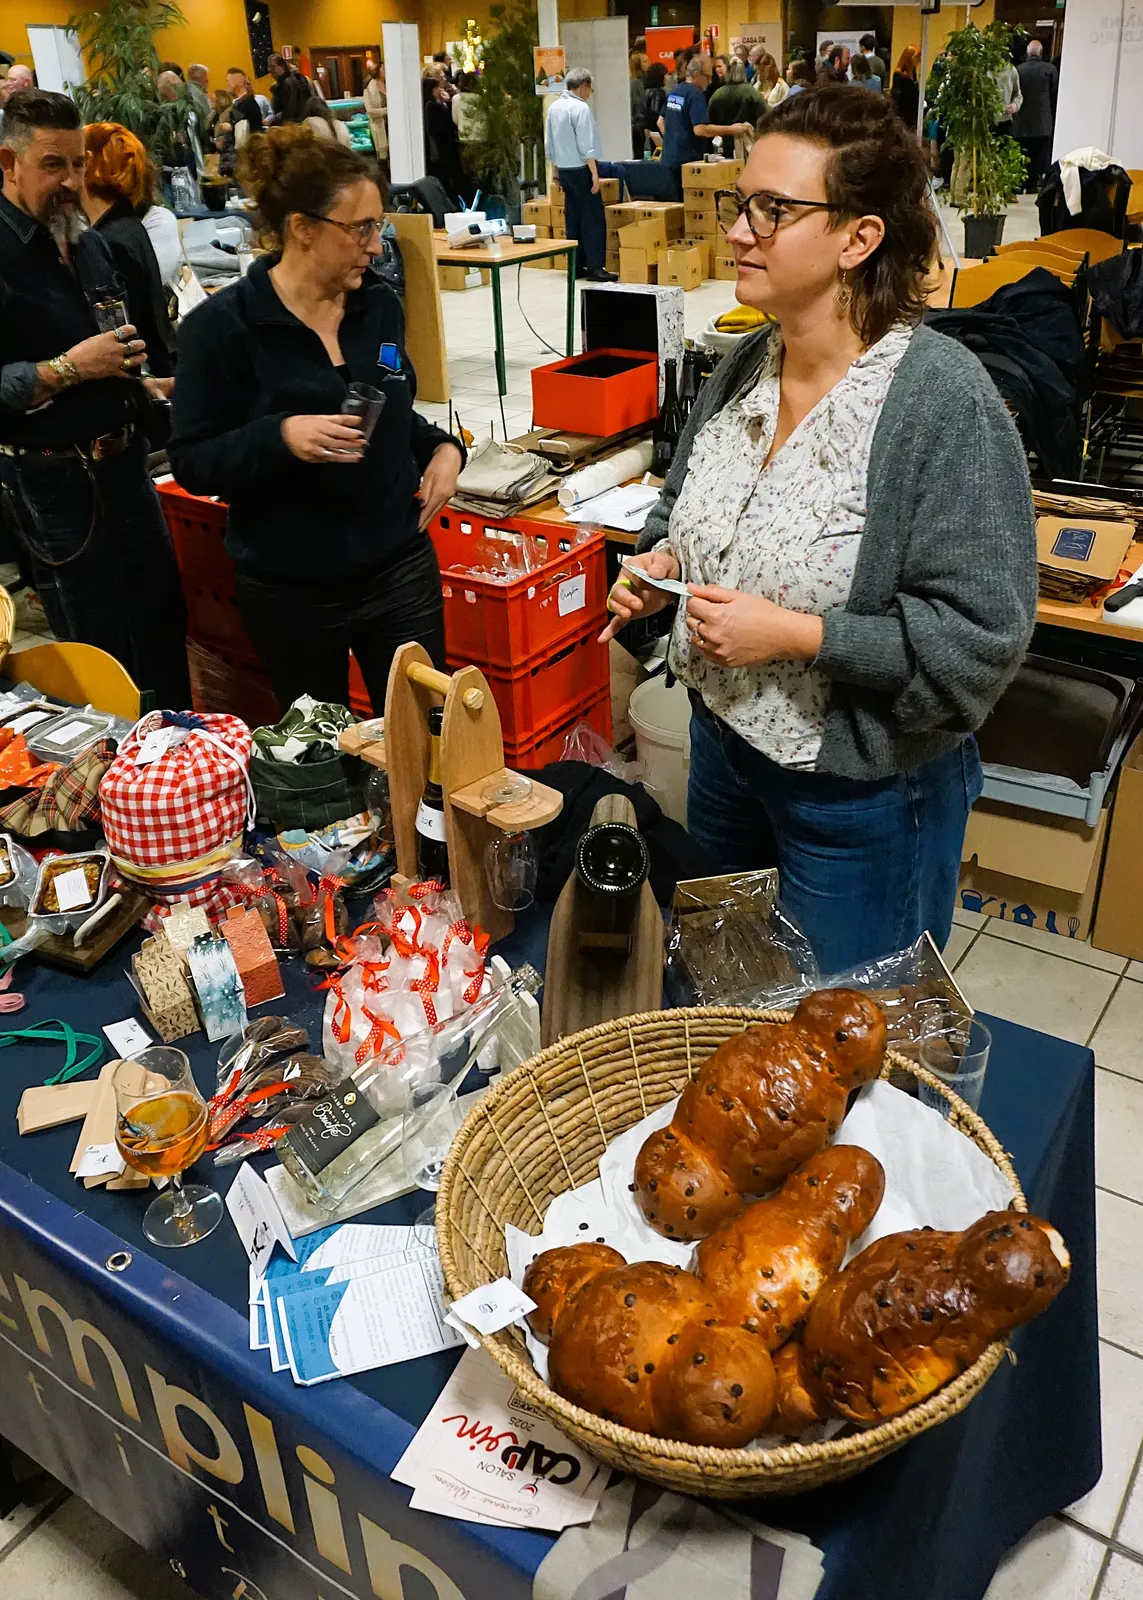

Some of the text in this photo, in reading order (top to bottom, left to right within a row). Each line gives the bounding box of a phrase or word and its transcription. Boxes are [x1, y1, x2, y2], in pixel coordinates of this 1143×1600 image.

[331, 1093, 357, 1127] CHAMPAGNE
[0, 1272, 467, 1600] mplin
[509, 1416, 535, 1431] 2025
[476, 1460, 515, 1481] SALON
